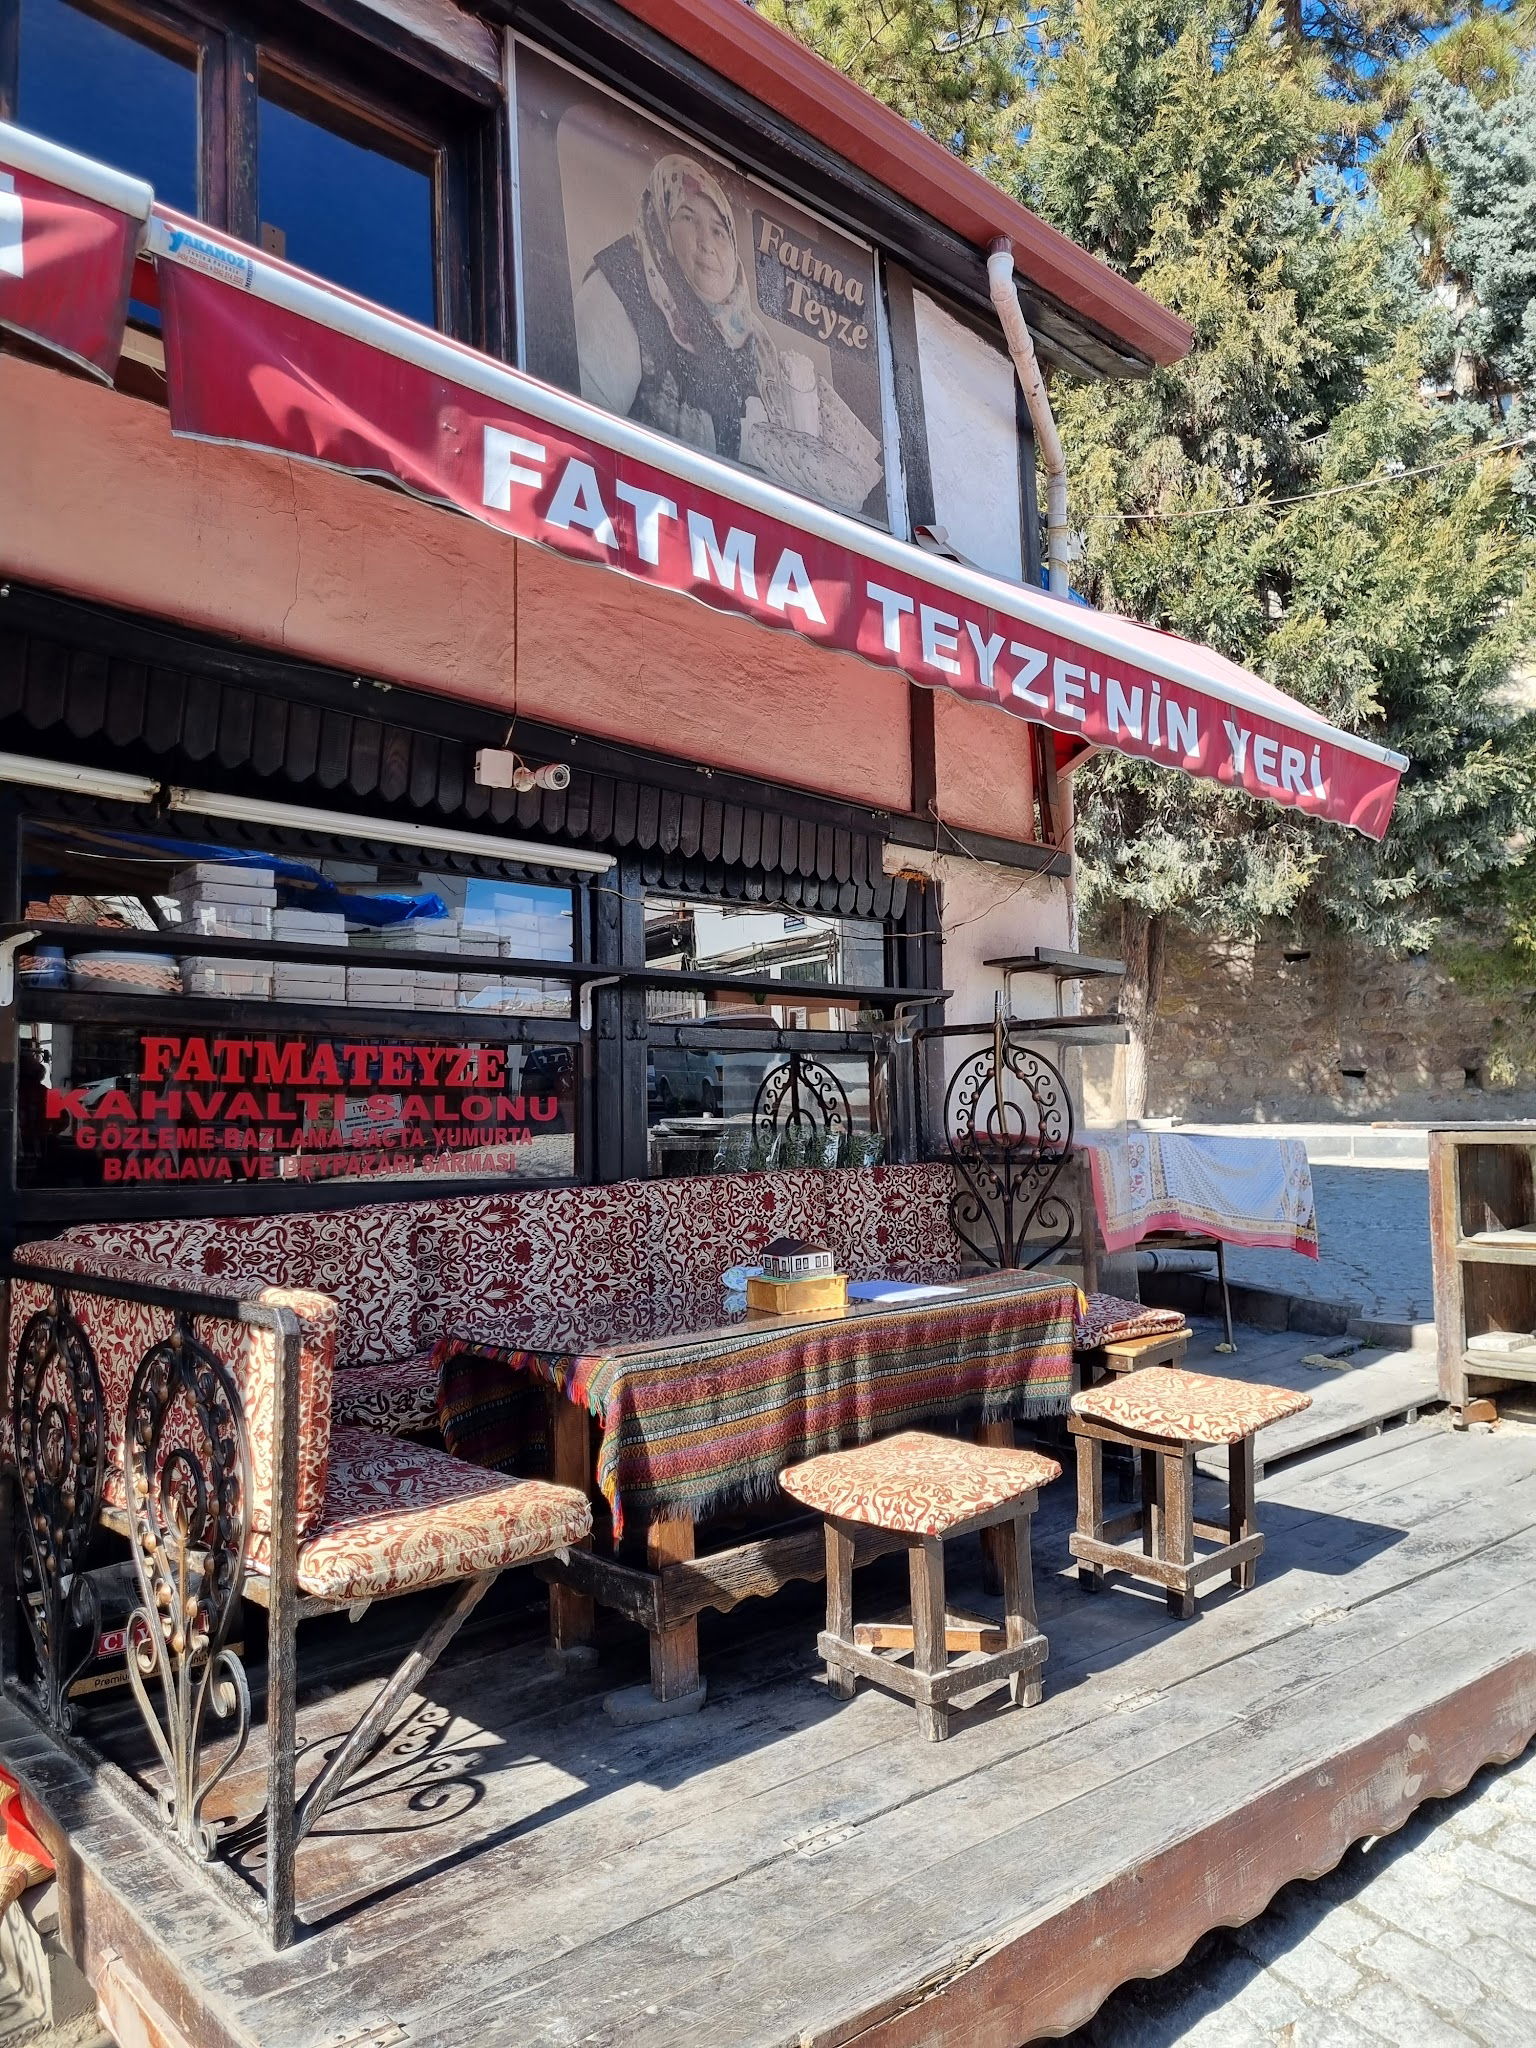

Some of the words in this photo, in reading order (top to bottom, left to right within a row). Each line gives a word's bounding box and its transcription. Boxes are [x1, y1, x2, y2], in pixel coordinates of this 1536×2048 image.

[757, 216, 864, 306] Fatma
[785, 275, 869, 350] Teyze
[482, 424, 827, 625] FATMA
[866, 580, 1201, 758] TEYZE'NİN
[1222, 719, 1327, 801] YERİ
[140, 1036, 506, 1088] FATMATEYZE
[46, 1088, 346, 1121] KAHVALTI
[366, 1094, 558, 1122] SALONU
[432, 1127, 533, 1149] YUMURTA
[103, 1156, 233, 1181] BAKLAVA
[241, 1156, 276, 1178] VE
[283, 1153, 416, 1178] BEYPAZARI
[421, 1152, 518, 1174] SARMASI
[94, 1672, 132, 1688] Premiu
